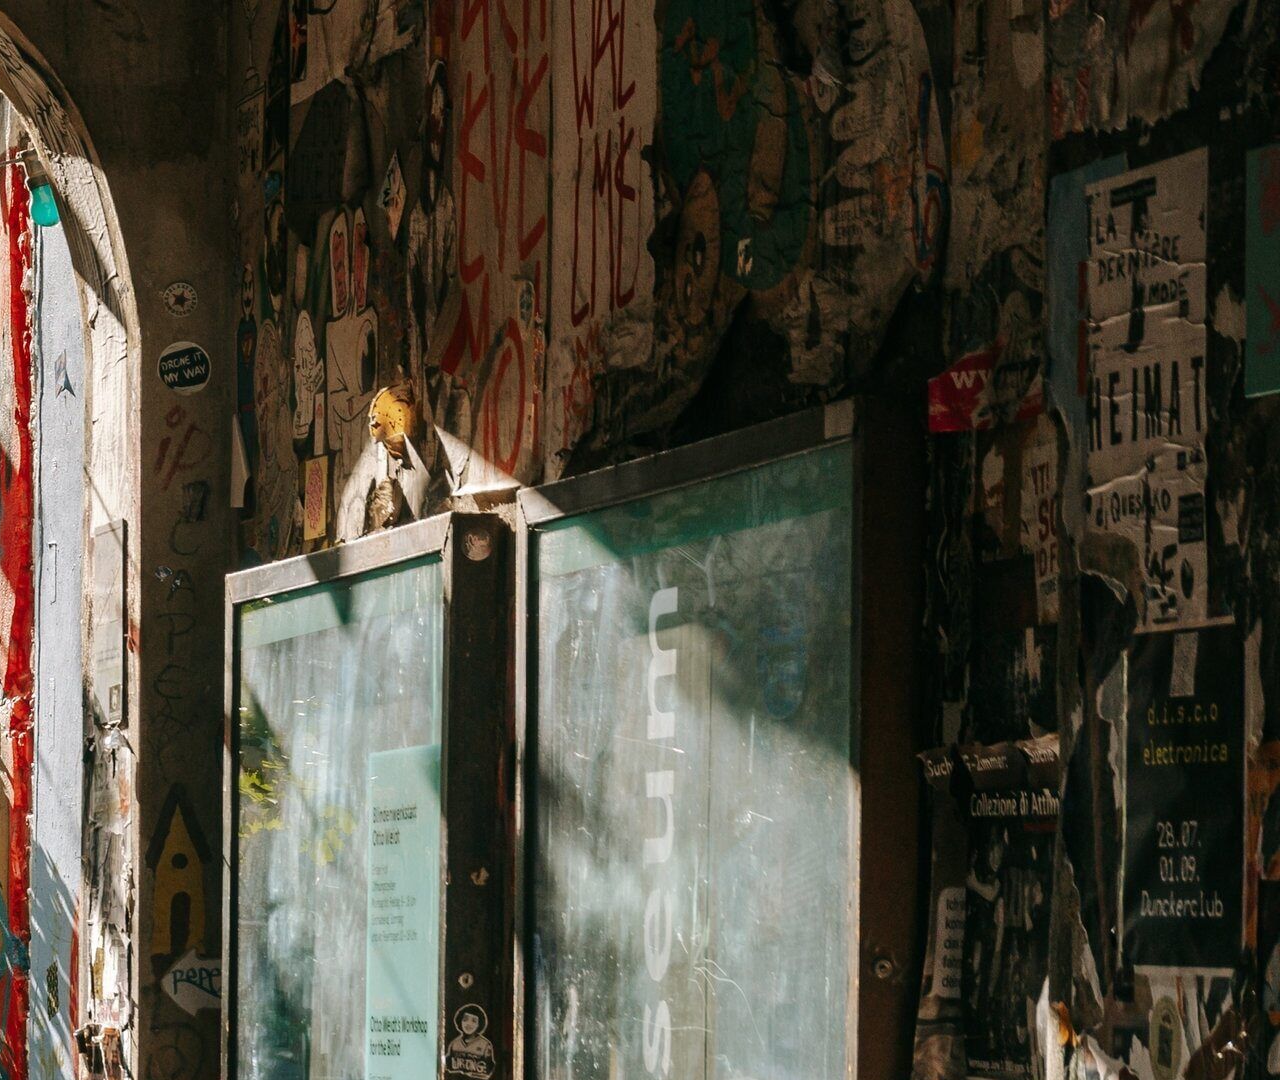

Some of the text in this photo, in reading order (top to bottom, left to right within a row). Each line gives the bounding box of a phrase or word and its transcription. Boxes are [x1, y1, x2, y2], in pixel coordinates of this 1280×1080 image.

[164, 364, 207, 383] MY WAY
[1143, 739, 1229, 767] electronica
[1140, 889, 1225, 919] Dunckerclub
